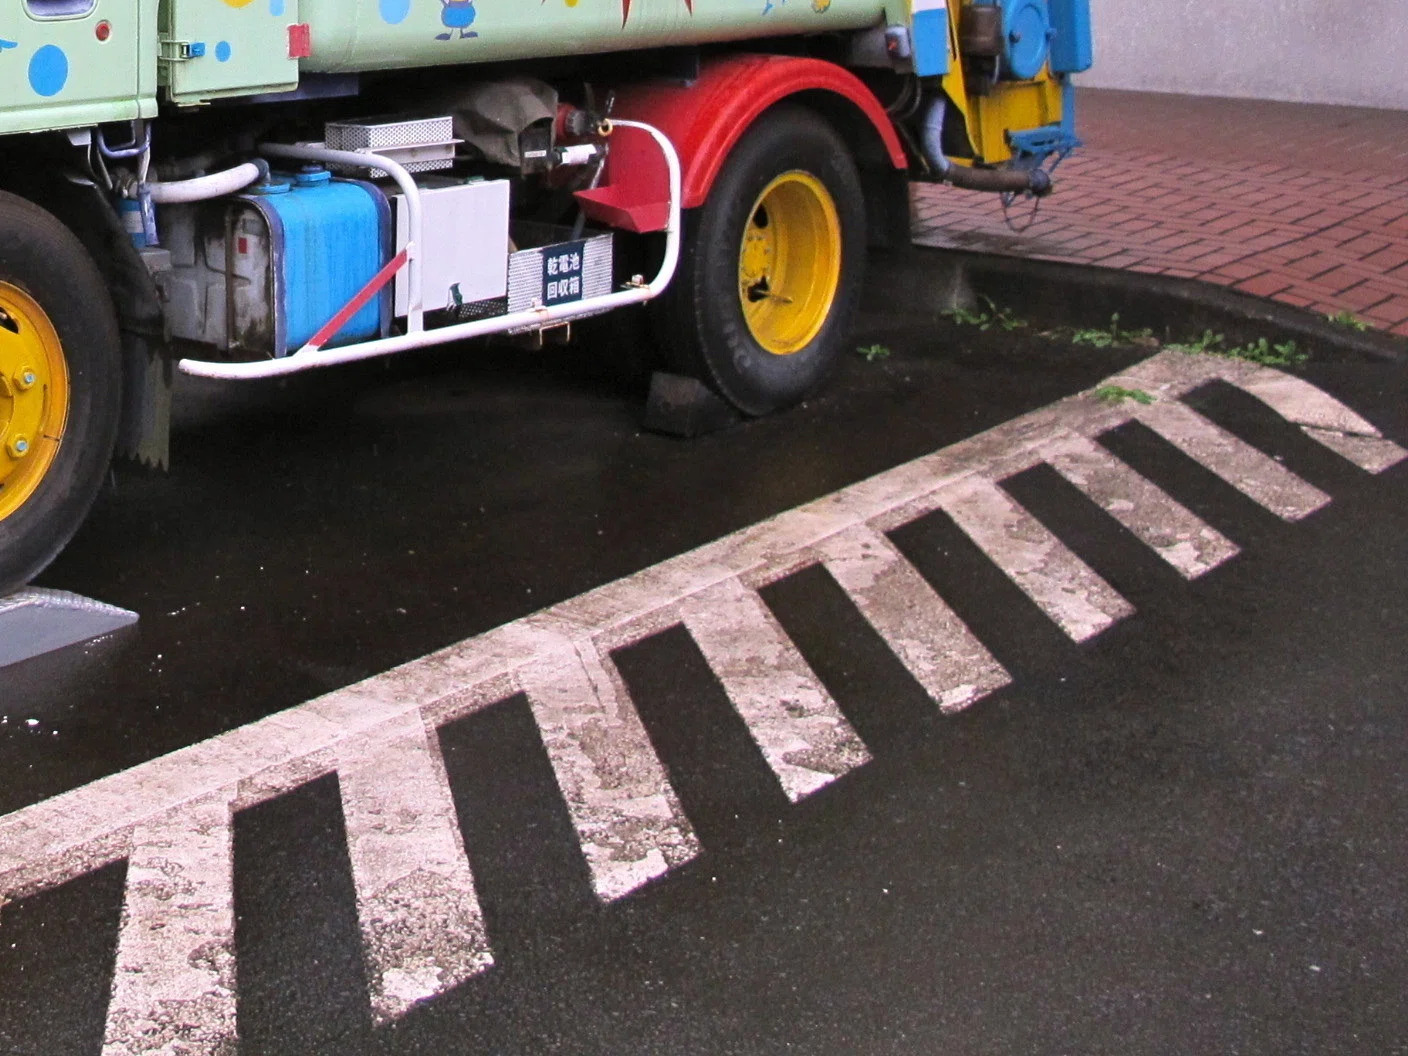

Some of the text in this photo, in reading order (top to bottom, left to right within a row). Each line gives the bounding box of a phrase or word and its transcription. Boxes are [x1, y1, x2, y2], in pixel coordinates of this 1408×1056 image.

[546, 252, 580, 276] 乾電池
[546, 275, 580, 300] 回収箱
